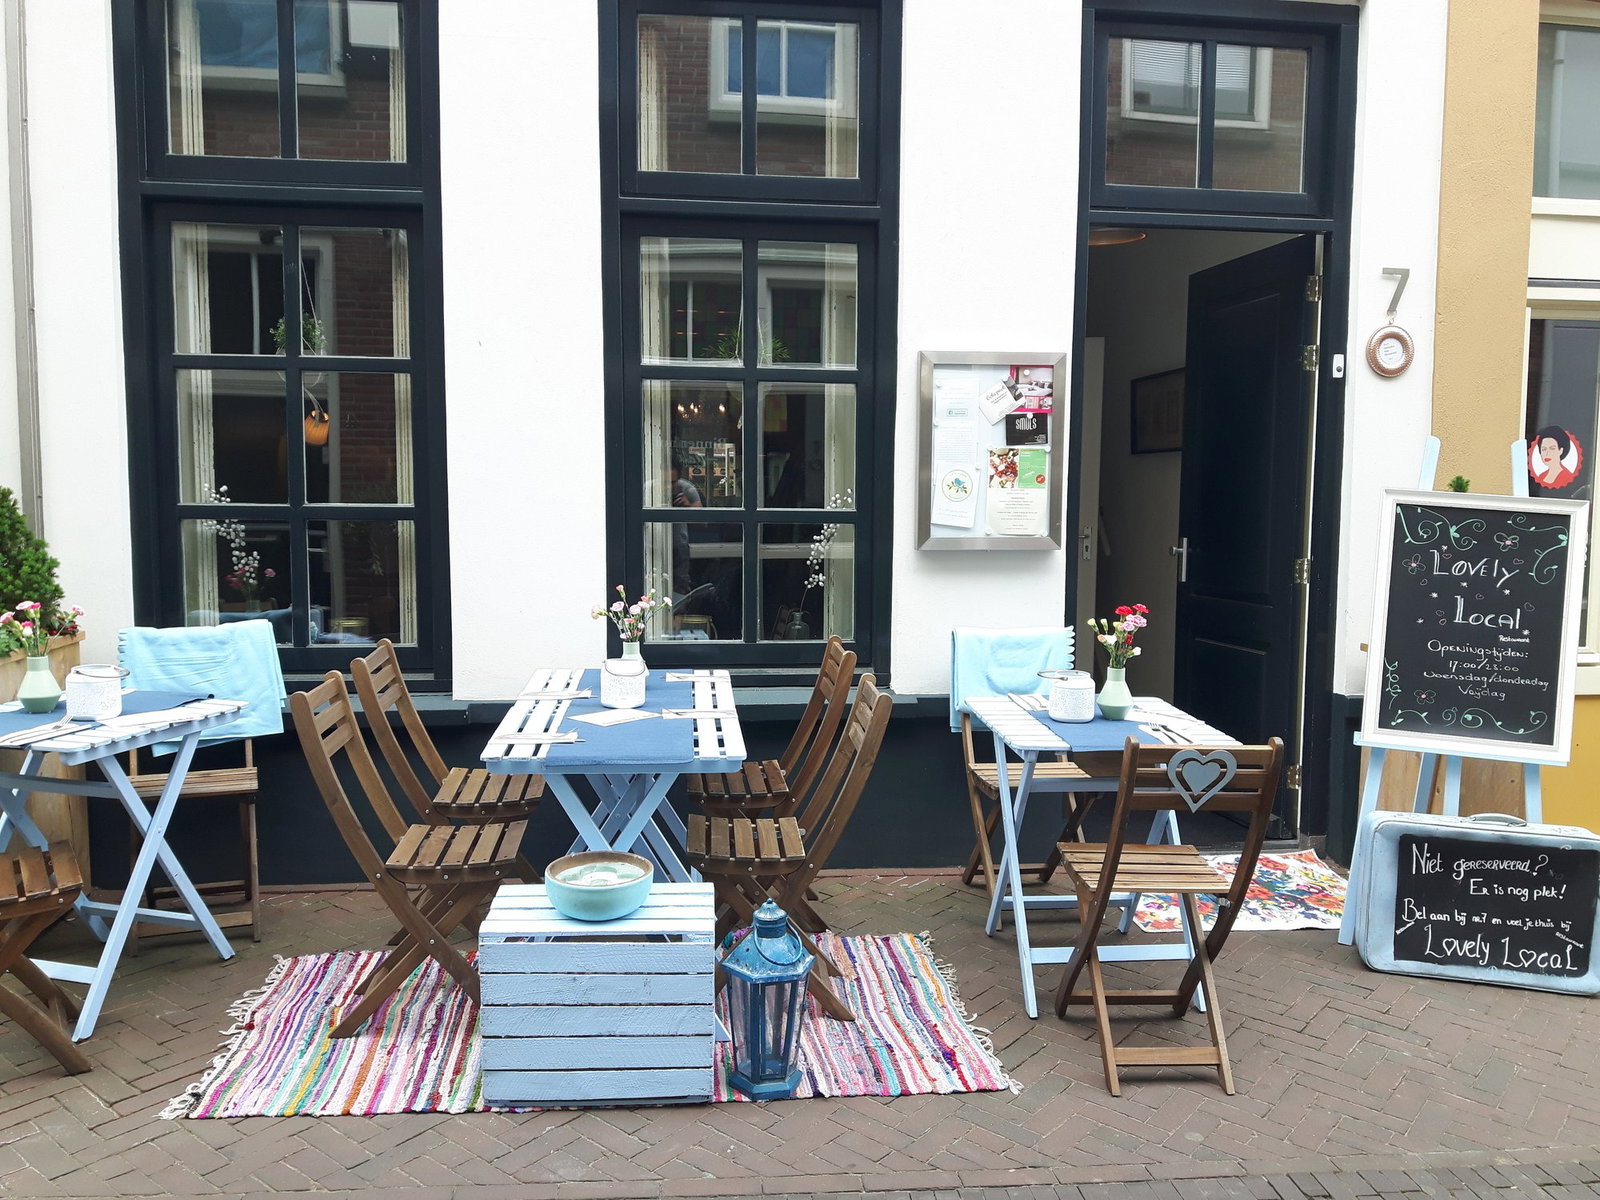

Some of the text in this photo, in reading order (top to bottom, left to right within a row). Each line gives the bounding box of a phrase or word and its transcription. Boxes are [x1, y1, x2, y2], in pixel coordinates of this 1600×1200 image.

[1382, 267, 1410, 313] 7
[1412, 843, 1444, 875] Niet
[1493, 884, 1504, 895] is
[1507, 887, 1529, 902] nog
[1533, 884, 1567, 901] plek!
[1402, 898, 1428, 922] Bel
[1430, 913, 1450, 922] aan
[1506, 919, 1523, 927] voel
